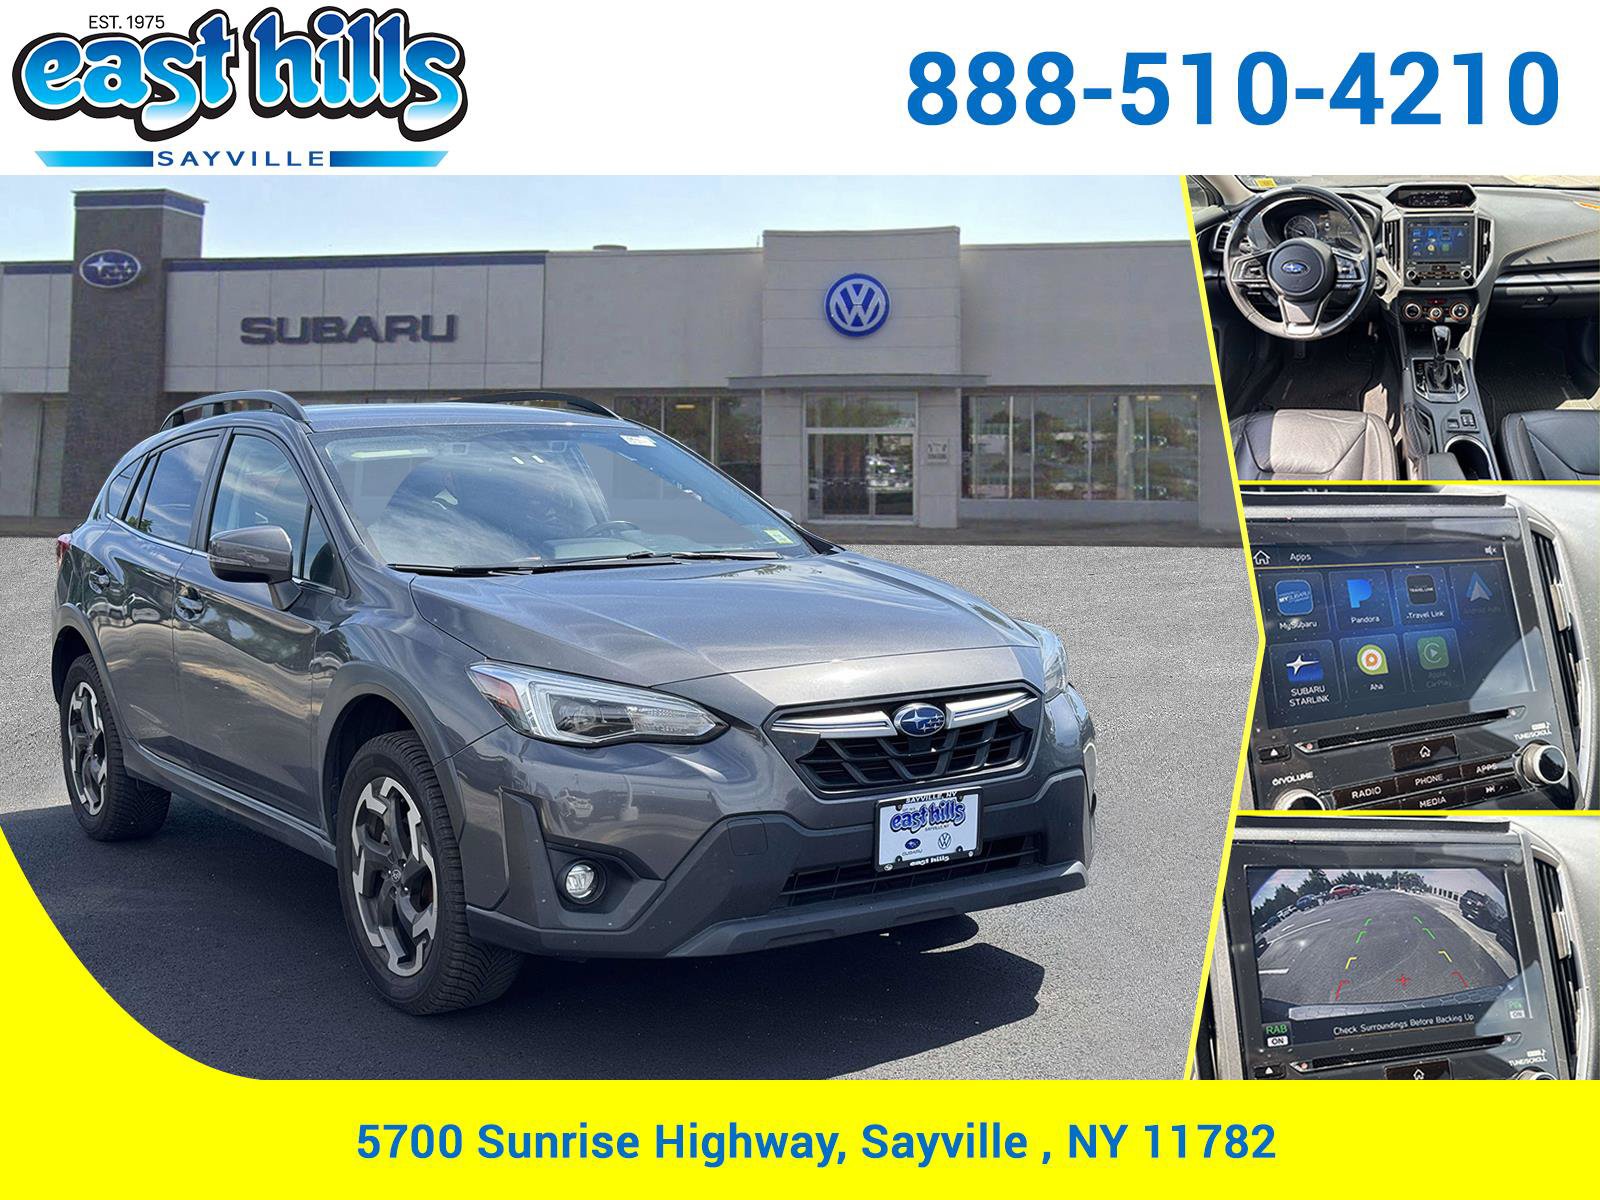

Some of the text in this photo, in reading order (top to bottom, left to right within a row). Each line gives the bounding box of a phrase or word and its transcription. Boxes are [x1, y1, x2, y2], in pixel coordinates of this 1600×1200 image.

[240, 314, 459, 345] SUBARU
[1290, 553, 1312, 562] Apps
[1351, 616, 1380, 624] Pandora
[1408, 610, 1445, 619] Travel Link
[1279, 621, 1318, 631] MySubaru
[1290, 685, 1326, 697] SUBARU
[1289, 694, 1330, 707] STARLINK
[1476, 763, 1498, 774] APPS
[1414, 774, 1444, 786] PHONE
[1351, 786, 1382, 799] RADIO
[1419, 796, 1447, 808] MEDIA
[890, 799, 966, 834] east hills
[1265, 1023, 1288, 1035] RAB
[1333, 1013, 1475, 1036] Check Surroundings Before Backing Up
[1270, 1037, 1285, 1045] ON
